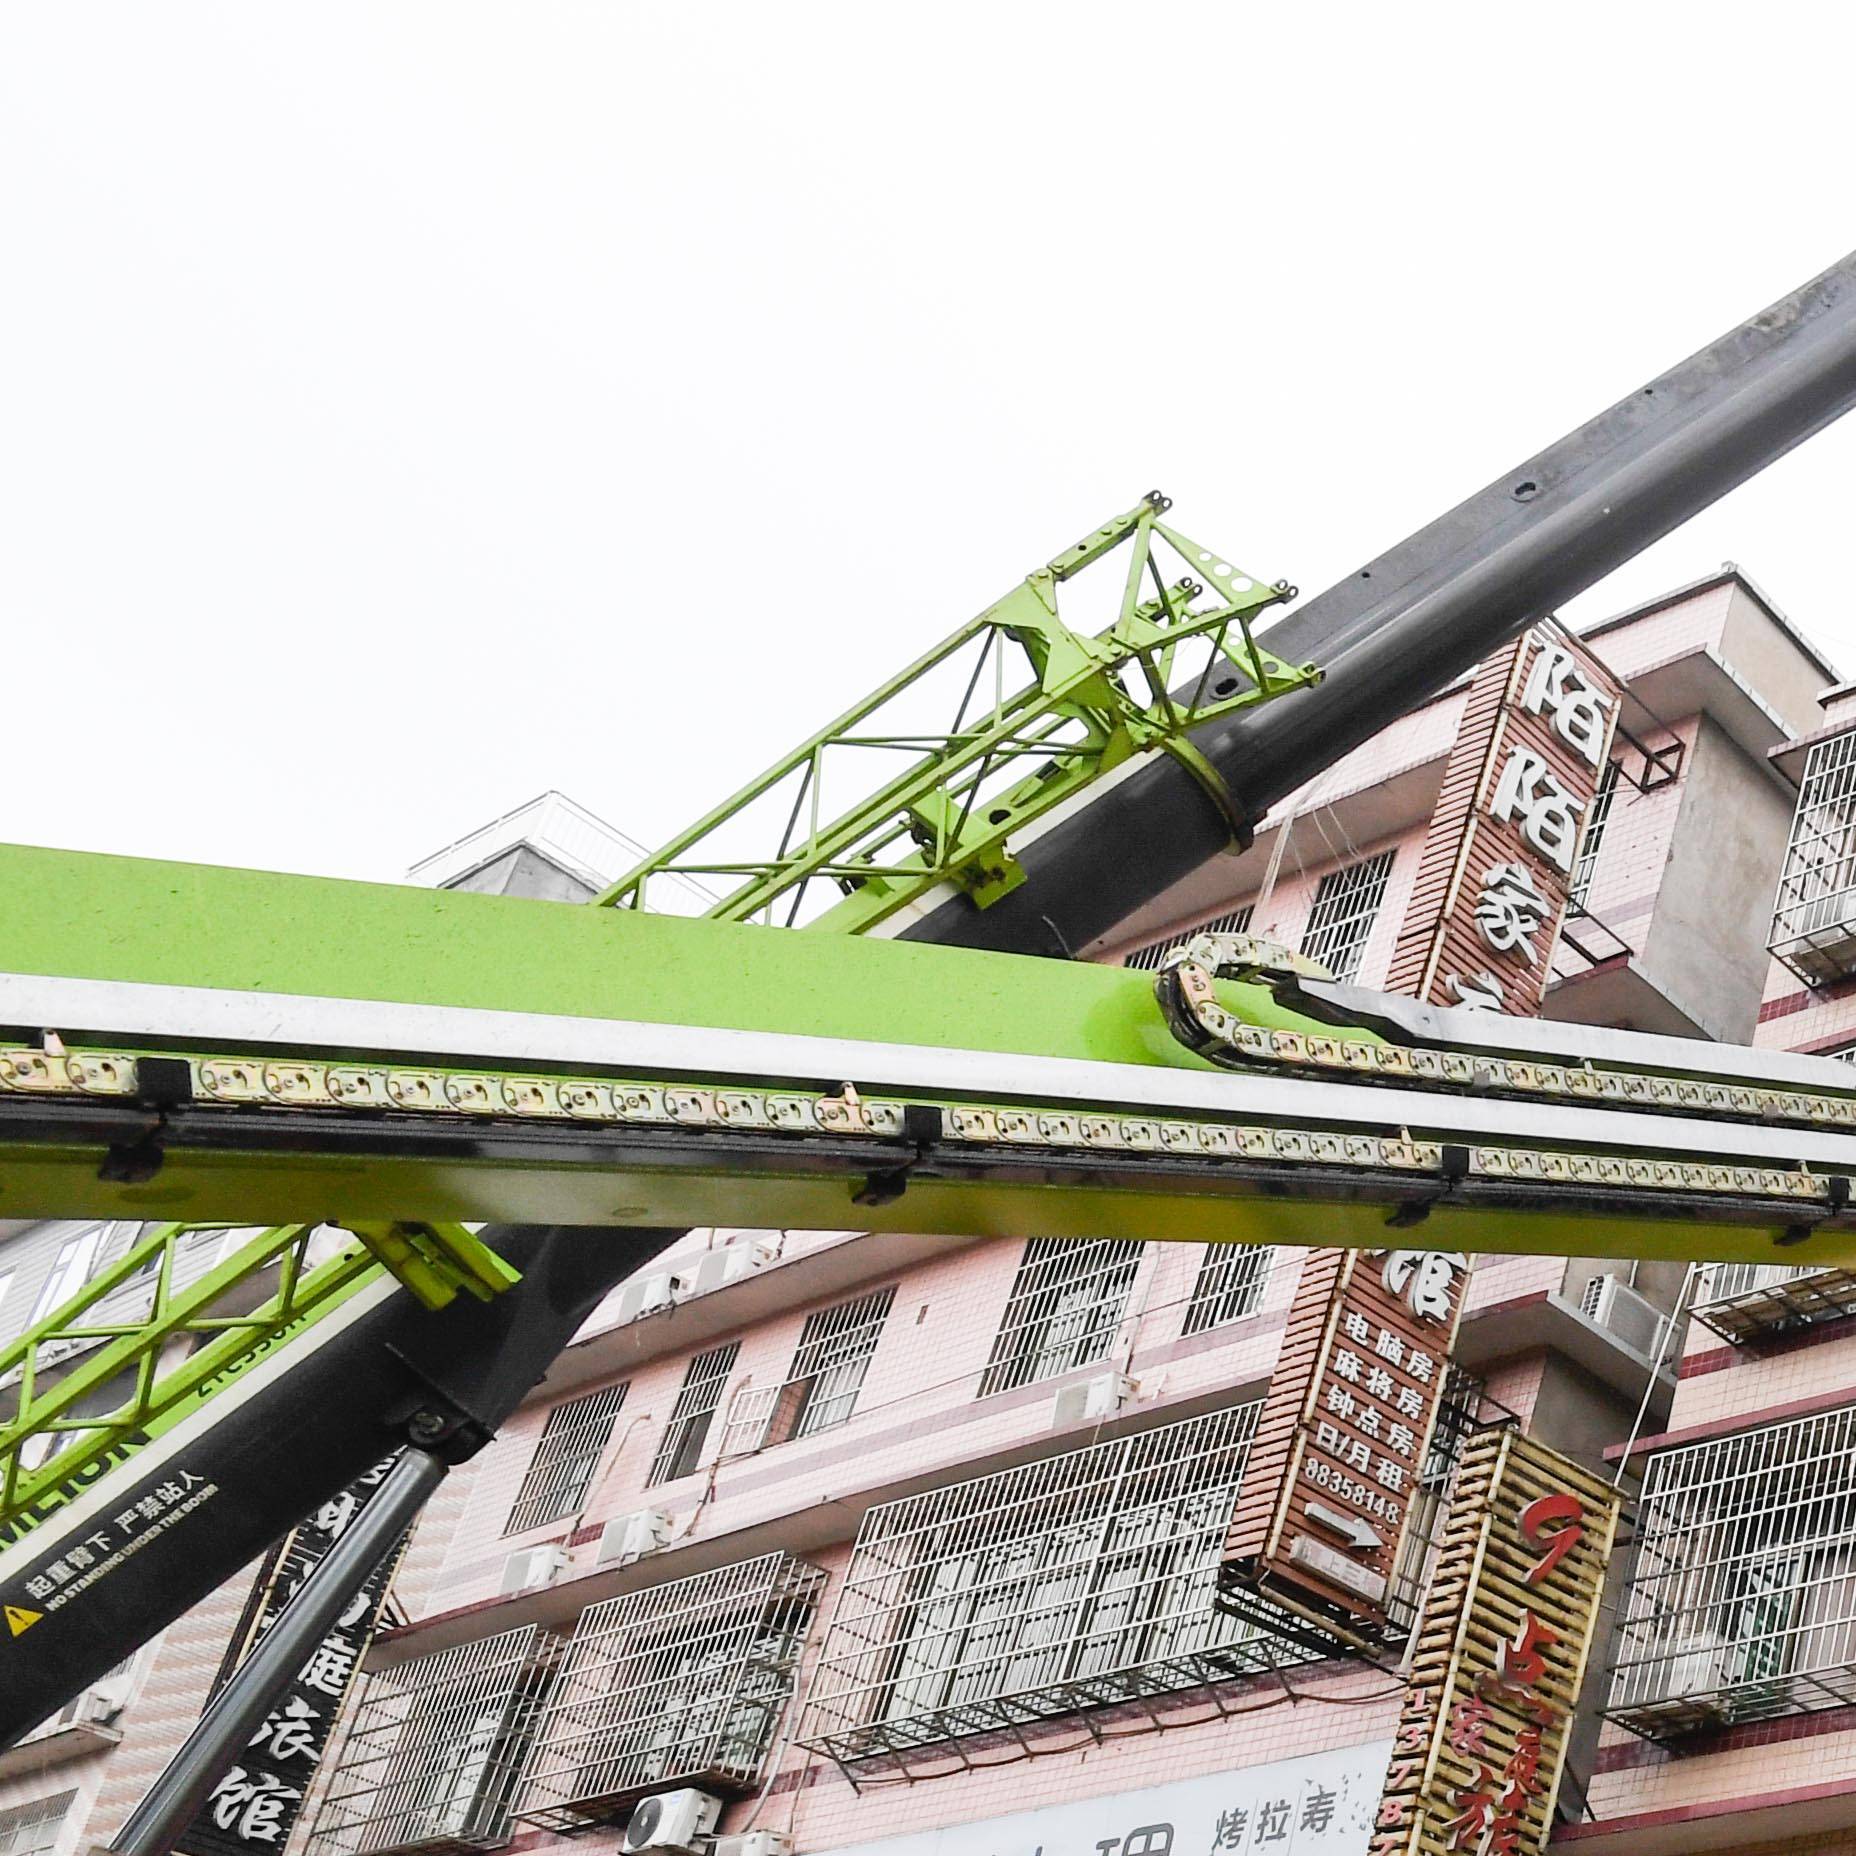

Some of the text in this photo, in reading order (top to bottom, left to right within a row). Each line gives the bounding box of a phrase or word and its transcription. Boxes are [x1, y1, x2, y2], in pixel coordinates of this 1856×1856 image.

[1332, 1347, 1425, 1420] 麻将房
[1344, 1311, 1435, 1385] 电脑房
[1326, 1383, 1416, 1458] 钟点房
[25, 1529, 113, 1600] 起重臂下
[114, 1468, 205, 1535] 严禁站人
[64, 1551, 124, 1600] STANDING
